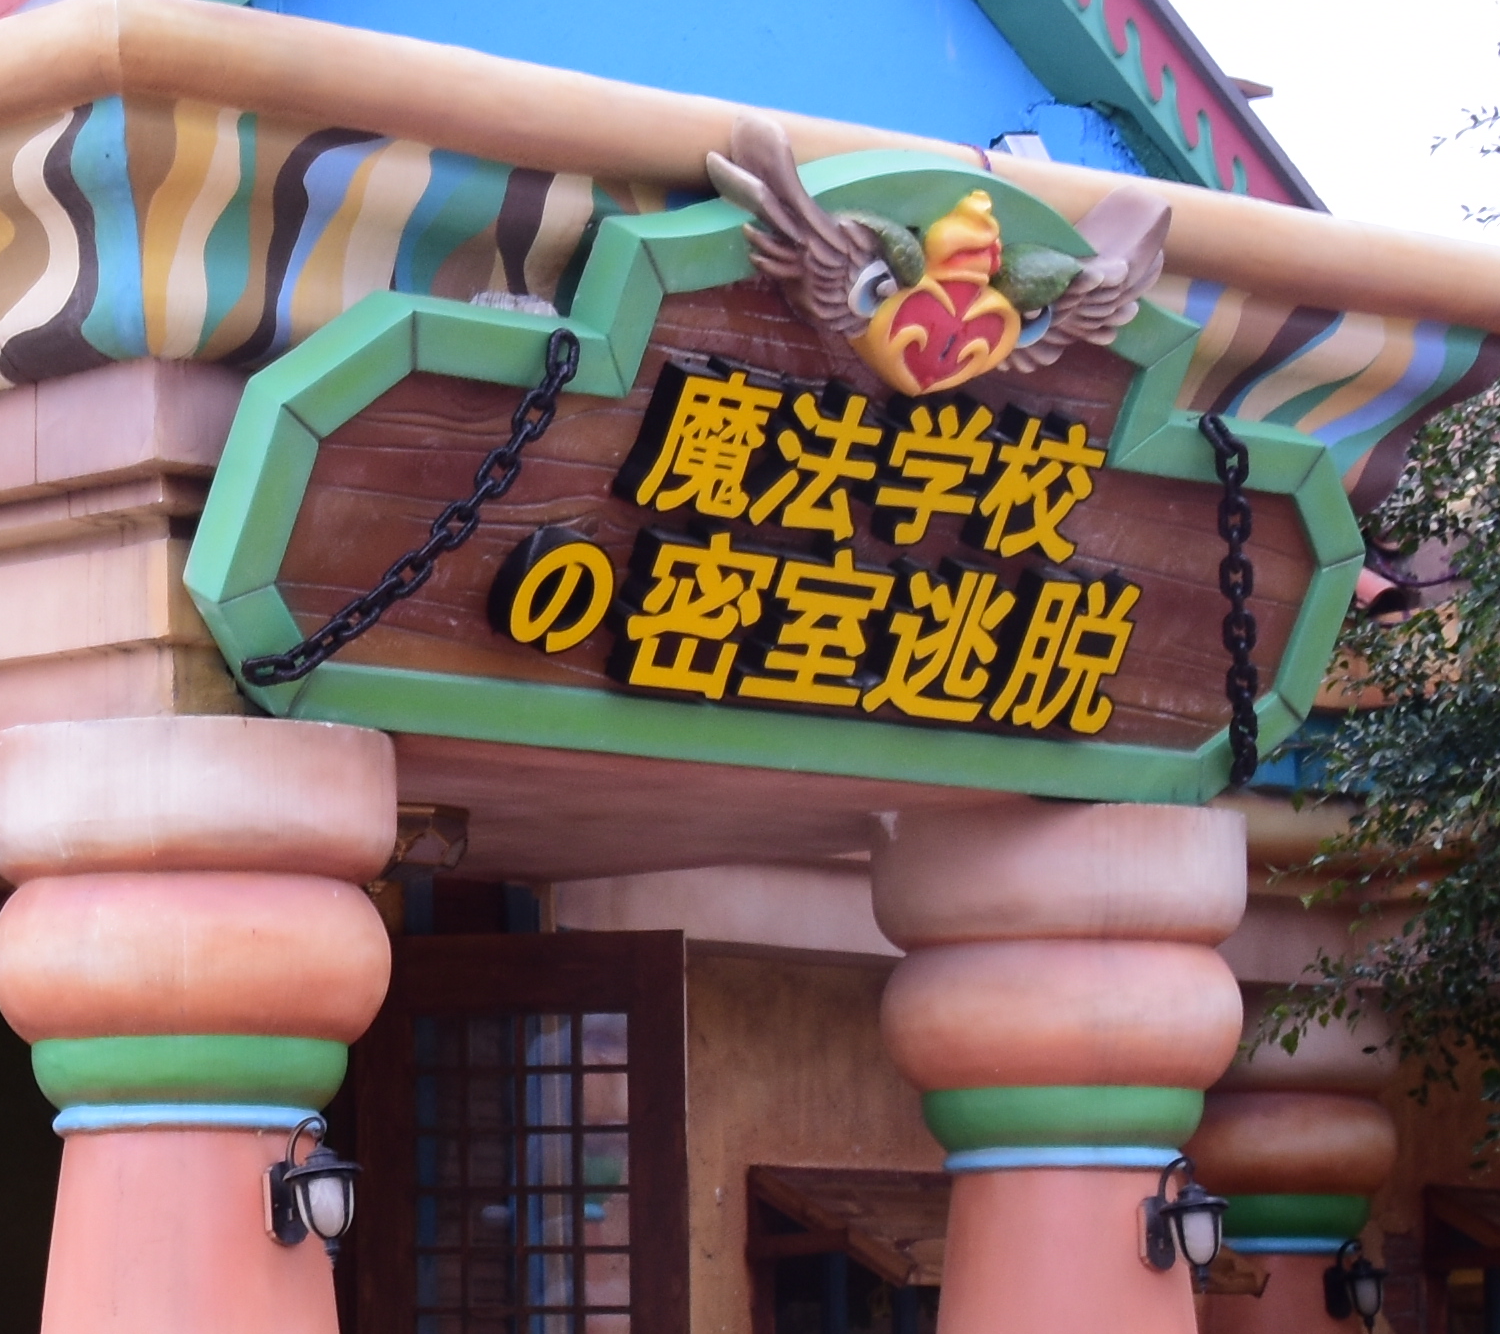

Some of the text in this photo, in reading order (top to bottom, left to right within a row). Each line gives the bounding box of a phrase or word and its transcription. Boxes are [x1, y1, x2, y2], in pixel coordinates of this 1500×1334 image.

[636, 370, 1106, 563] 魔法学校
[509, 531, 1141, 735] の密室逃脱
